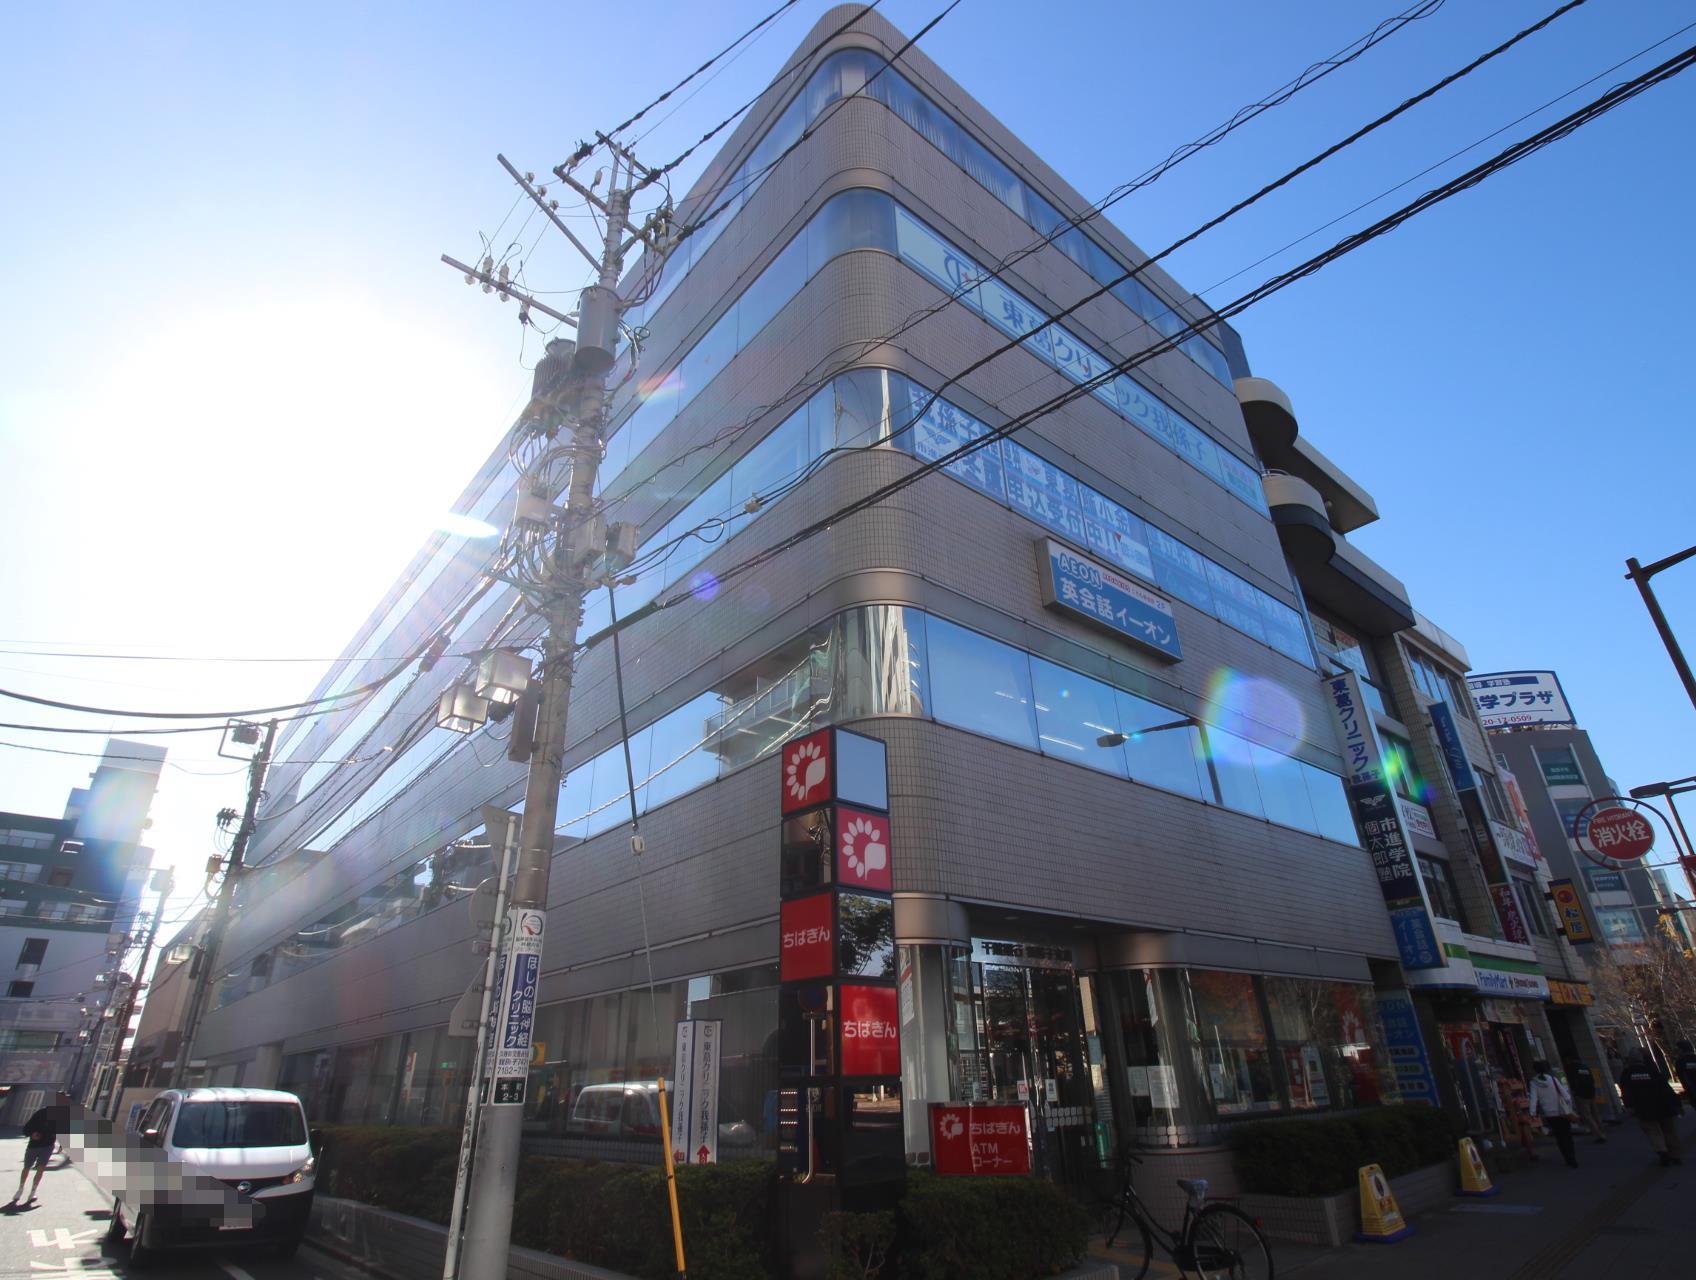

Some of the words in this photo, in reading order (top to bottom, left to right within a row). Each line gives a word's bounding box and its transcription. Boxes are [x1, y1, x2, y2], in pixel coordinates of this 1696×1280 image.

[1059, 553, 1102, 588] AEON
[1060, 577, 1170, 645] 英会話イーオン
[1330, 678, 1369, 772] 東葛クリニック
[1380, 817, 1412, 879] 市進学院
[1593, 820, 1650, 848] 消火栓
[1365, 820, 1392, 881] 個太郎塾
[783, 926, 830, 948] ちばぎん
[1399, 920, 1416, 965] イーオン
[506, 991, 522, 1046] クリニック
[843, 1020, 897, 1039] ちばぎん
[503, 1093, 518, 1101] 2-3
[970, 1121, 1021, 1135] ちばぎん
[972, 1143, 998, 1154] ATM
[973, 1155, 1013, 1168] コーナー
